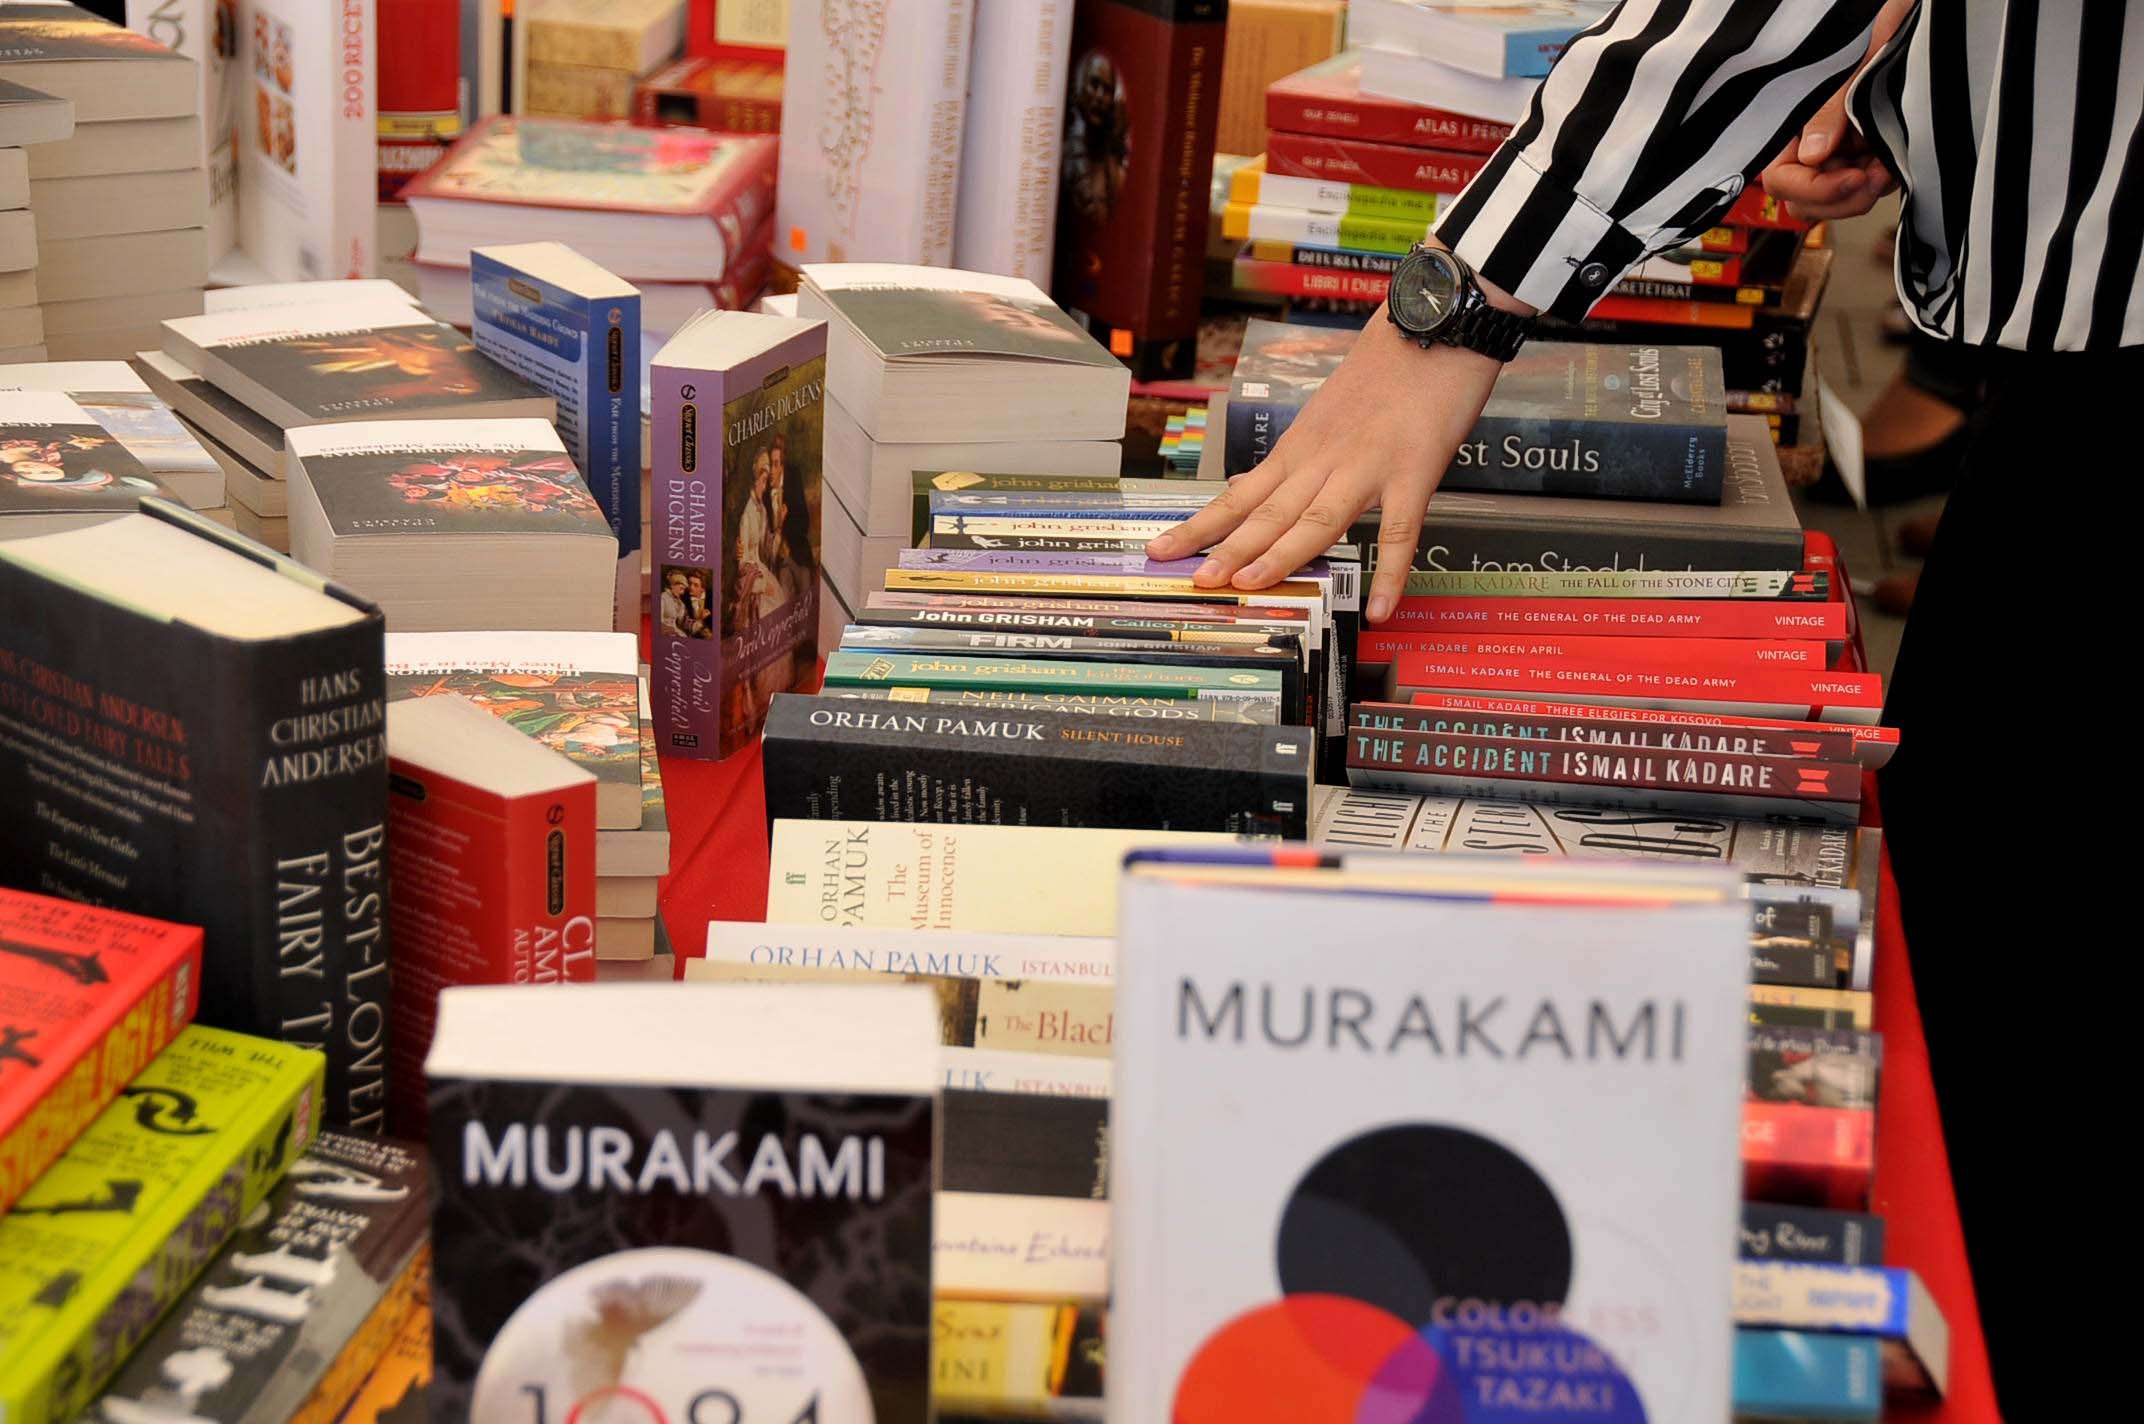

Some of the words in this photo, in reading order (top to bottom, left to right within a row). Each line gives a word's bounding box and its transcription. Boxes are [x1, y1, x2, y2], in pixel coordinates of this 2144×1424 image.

[343, 68, 365, 121] 200
[1415, 118, 1458, 136] ATLAS
[1415, 166, 1460, 183] ATLAS
[1629, 347, 1661, 373] Souls
[1629, 373, 1660, 391] Lost
[728, 403, 777, 448] CHARLES
[772, 376, 824, 422] DICKENS
[1630, 400, 1671, 419] City
[1456, 436, 1490, 469] st
[1501, 434, 1601, 474] Souls
[1683, 434, 1699, 489] McElderry
[991, 476, 1042, 490] john
[1046, 478, 1138, 493] grisham
[668, 479, 685, 561] DICKENS
[689, 479, 706, 563] CHARLES
[1012, 522, 1062, 532] john
[1069, 523, 1161, 534] grisham
[1017, 537, 1071, 549] john
[1075, 539, 1150, 552] grisha
[988, 555, 1041, 566] john
[1048, 557, 1142, 569] grisham
[972, 576, 1026, 586] john
[1404, 576, 1464, 592] SMAIL
[1472, 575, 1551, 594] KADARE
[1559, 579, 1584, 589] THE
[1587, 578, 1620, 589] FALL
[1621, 579, 1640, 589] OF
[1641, 579, 1664, 589] THE
[1666, 577, 1715, 589] STONE
[1716, 576, 1752, 590] CITY
[957, 598, 1018, 609] john
[1020, 600, 1121, 612] grisham
[910, 609, 973, 624] John
[977, 612, 1095, 629] GRISHAM
[1110, 618, 1177, 630] Calico
[1182, 622, 1214, 631] Joe
[1395, 610, 1436, 621] ISMAIL
[1439, 611, 1490, 622] KADARE
[1497, 611, 1521, 622] THE
[1523, 612, 1580, 623] GENERAL
[1582, 613, 1600, 623] OF
[1602, 613, 1627, 624] THE
[1630, 613, 1665, 625] DEAD
[1667, 614, 1703, 626] ARMY
[1774, 615, 1825, 627] VINTAGE
[968, 633, 1074, 650] FIRM
[1374, 641, 1415, 653] ISMAIL
[1419, 642, 1469, 654] KADARE
[1476, 644, 1527, 656] BROKEN
[1529, 644, 1564, 656] APRIL
[1755, 649, 1808, 662] VINTAGE
[488, 667, 584, 677] JEROME
[910, 660, 968, 674] john
[974, 663, 1078, 677] grisham
[1424, 664, 1467, 675] ISMAIL
[1470, 666, 1522, 678] KADARE
[1528, 668, 1553, 680] THE
[1556, 670, 1613, 683] GENERAL
[1615, 673, 1633, 684] OF
[1636, 673, 1662, 686] THE
[1664, 675, 1699, 687] DEAD
[1702, 676, 1738, 689] ARMY
[1809, 682, 1862, 695] VINTAGE
[301, 668, 362, 705] HANS
[962, 690, 1029, 702] NEIL
[1043, 693, 1177, 708] GAIMAN
[270, 700, 385, 747] CHRISTIAN
[1108, 706, 1200, 721] GODS
[1441, 697, 1483, 709] ISMAIL
[1487, 700, 1538, 713] KADARE
[1546, 704, 1584, 718] THREE
[1588, 707, 1638, 722] ELEGIES
[1641, 712, 1667, 724] FOR
[809, 709, 929, 734] ORHAN
[935, 718, 1046, 742] PAMUK
[1060, 728, 1122, 745] SILENT
[1126, 734, 1186, 748] HOUSE
[1357, 713, 1405, 731] THE
[1417, 719, 1549, 741] ACCIDENT
[1559, 725, 1658, 748] ISMAIL
[1661, 731, 1767, 755] KADARE
[261, 731, 387, 788] ANDERSEN
[1356, 736, 1405, 764] THE
[1415, 742, 1552, 775] ACCIDENT
[1561, 750, 1657, 783] ISMAIL
[1665, 757, 1774, 789] KADARE
[912, 826, 934, 850] of
[819, 839, 842, 923] ORHAN
[886, 863, 908, 903] The
[932, 835, 957, 931] Innocence
[278, 850, 330, 979] FAIRY
[1754, 905, 1778, 930] of
[749, 944, 876, 972] ORHAN
[884, 951, 1004, 977] PAMUK
[1020, 958, 1115, 978] ISTANBUL
[1004, 1015, 1034, 1033] The
[1174, 973, 1690, 1063] MURAKAMI
[461, 1117, 888, 1201] MURAKAMI
[1431, 1296, 1662, 1338] COLORESS
[1472, 1375, 1616, 1414] TAZAKI
